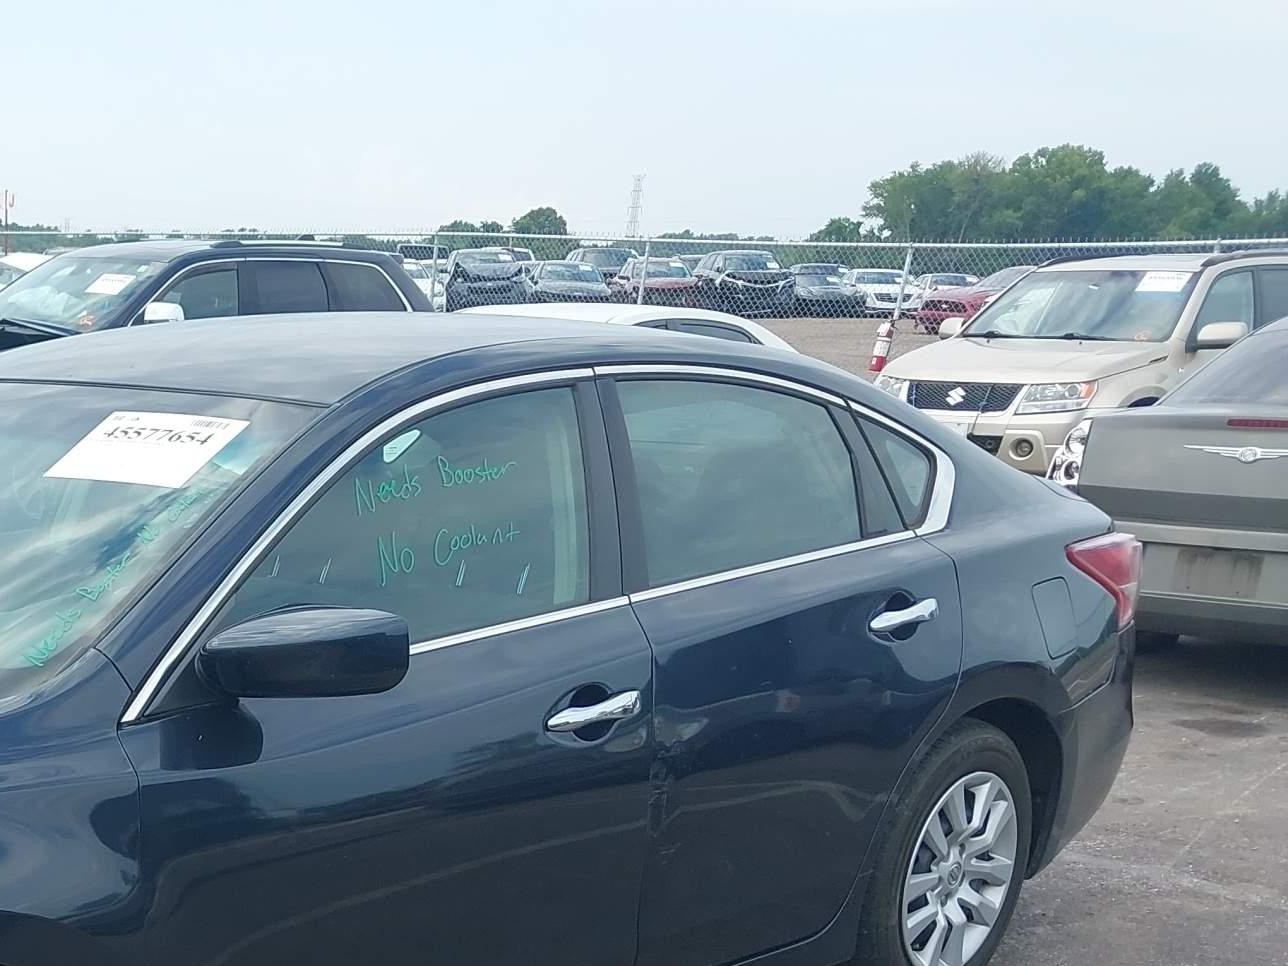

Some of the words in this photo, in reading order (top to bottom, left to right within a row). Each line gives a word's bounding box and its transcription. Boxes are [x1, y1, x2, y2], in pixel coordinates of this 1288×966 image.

[103, 425, 215, 447] 45577654
[354, 464, 422, 516] Needs
[437, 455, 516, 487] Booster
[377, 531, 414, 587] No
[434, 521, 521, 566] Coolant
[24, 607, 82, 667] Needs
[75, 552, 130, 601] Booster
